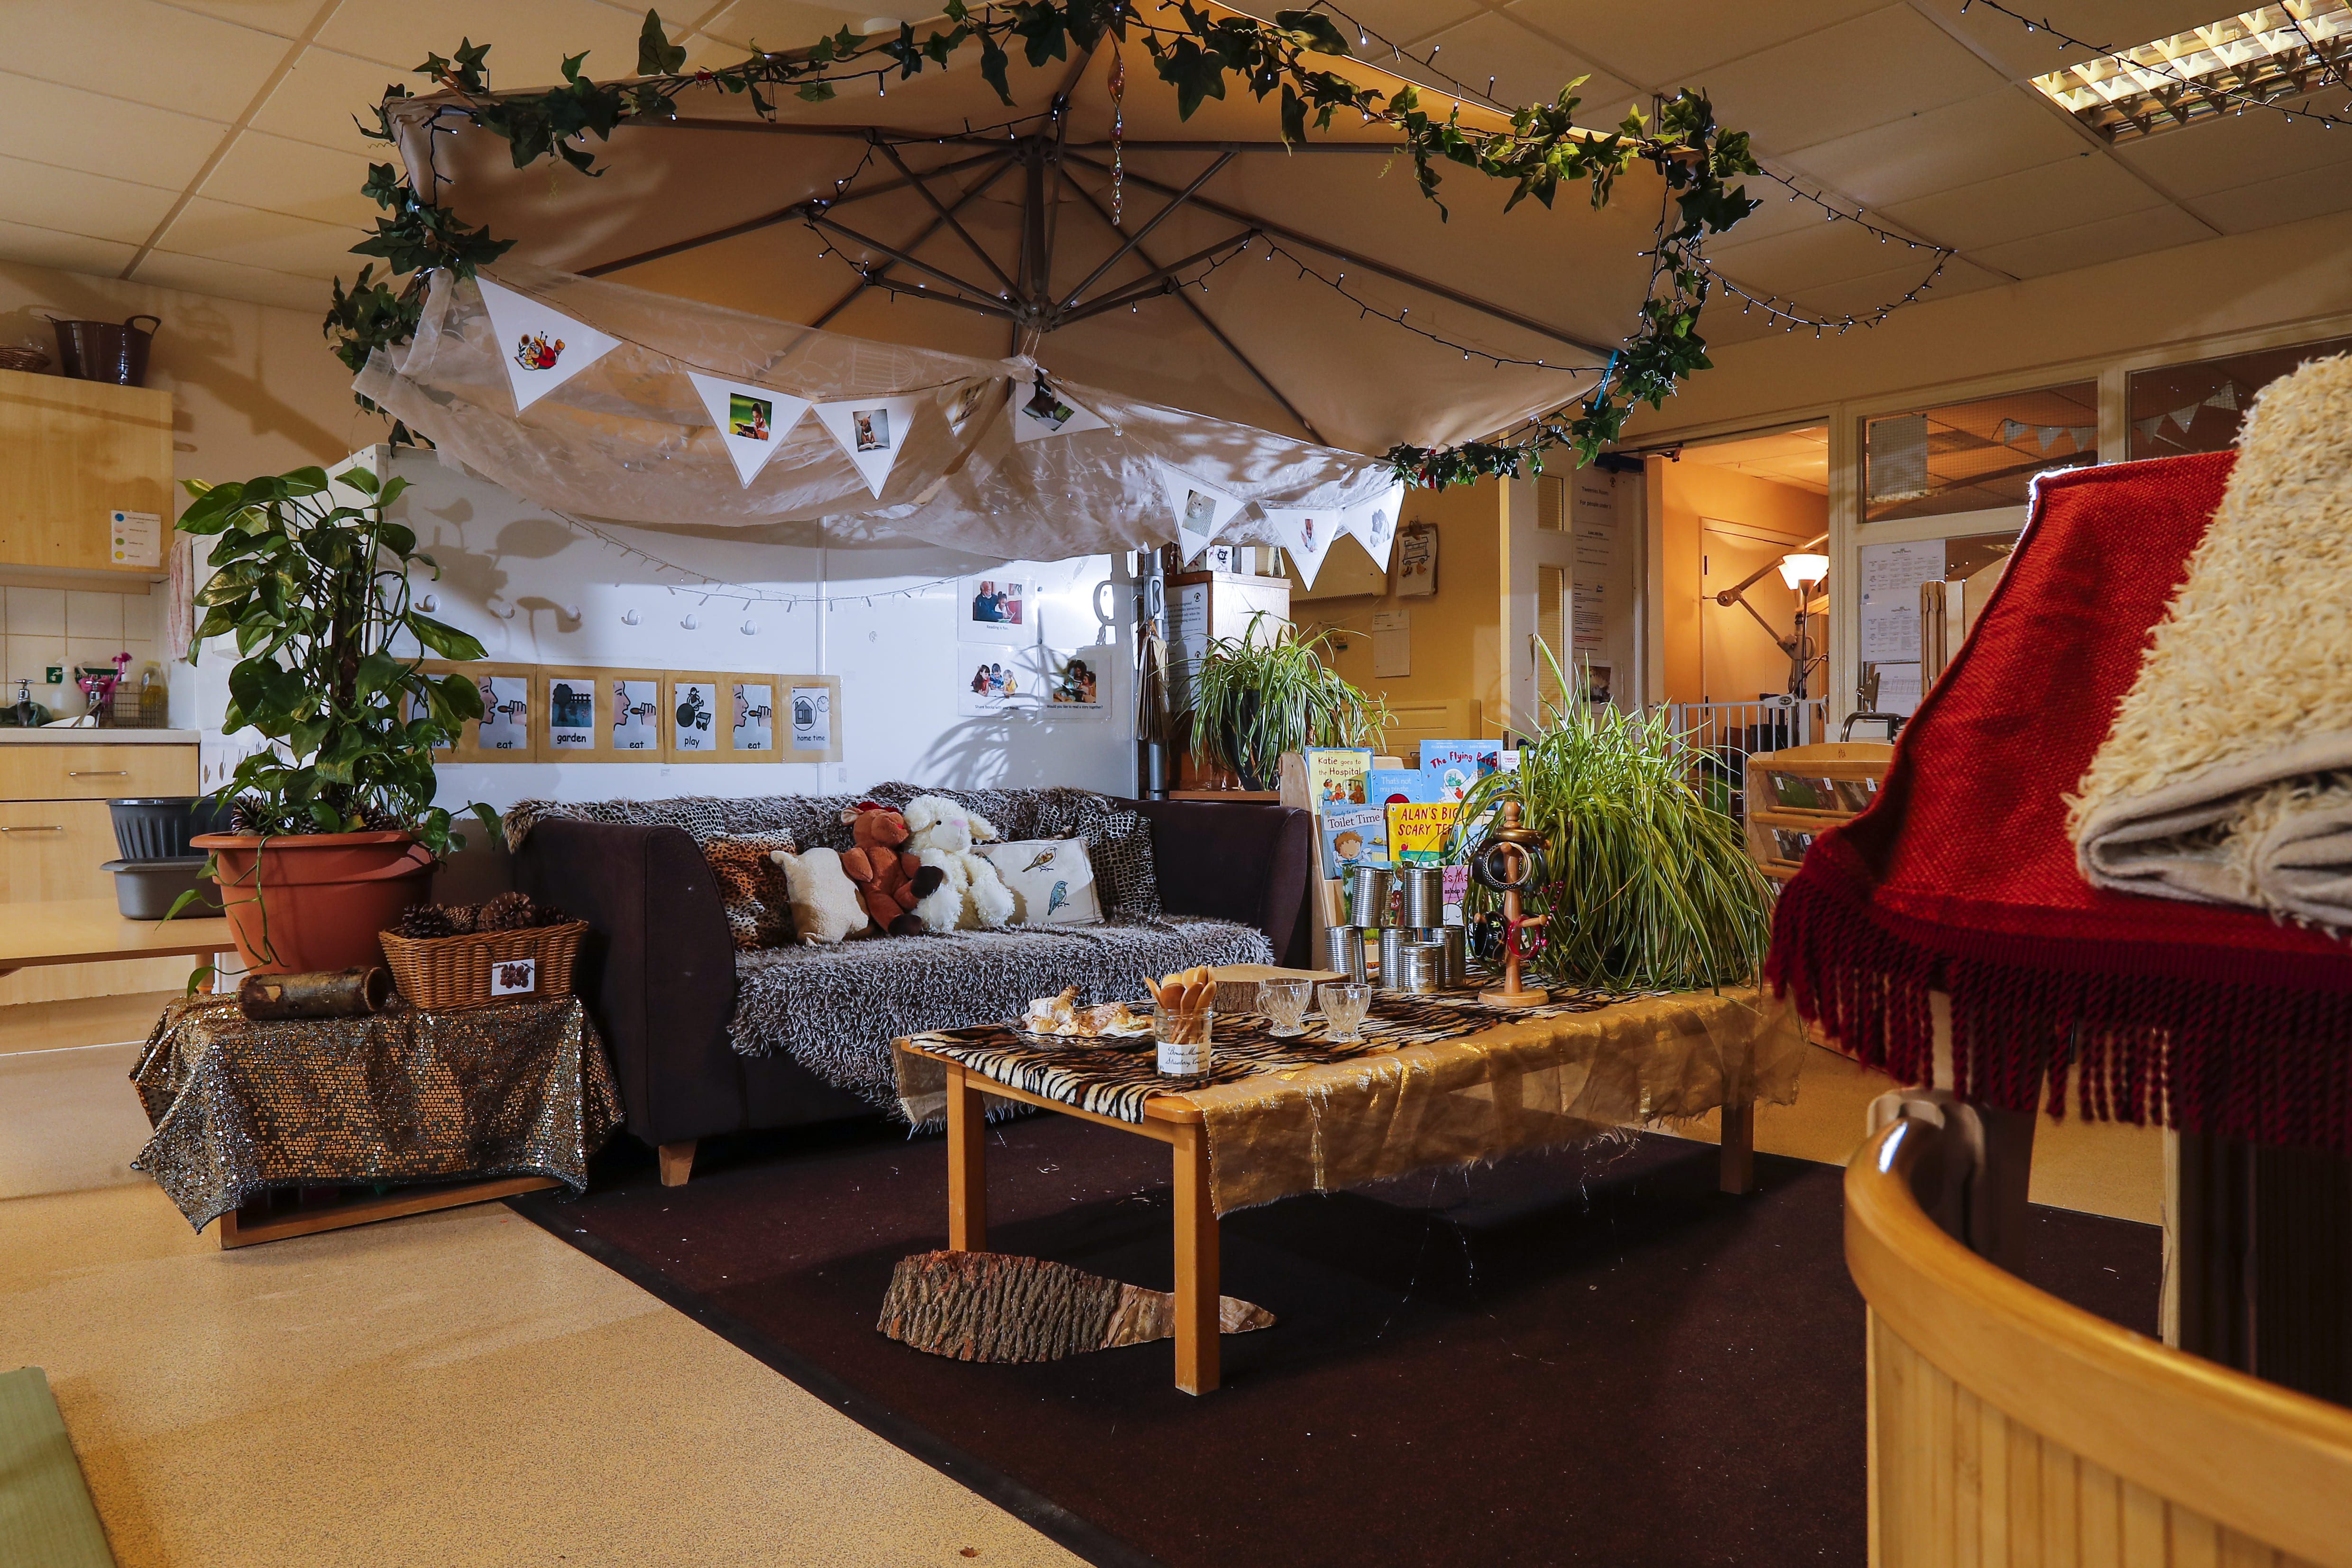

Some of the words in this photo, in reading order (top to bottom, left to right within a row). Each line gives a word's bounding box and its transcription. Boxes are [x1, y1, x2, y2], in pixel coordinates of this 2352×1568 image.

[557, 733, 586, 744] garden
[684, 736, 700, 748] play
[496, 741, 513, 749] eat
[1318, 757, 1338, 765] Katie
[1430, 757, 1447, 768] The
[1449, 751, 1472, 762] Flying
[1330, 767, 1361, 777] Hospital
[1381, 777, 1399, 785] That's
[1401, 807, 1438, 821] ALAN'S
[1328, 817, 1355, 829] Toilet
[1356, 815, 1380, 824] Time
[1398, 824, 1431, 836] SCARY
